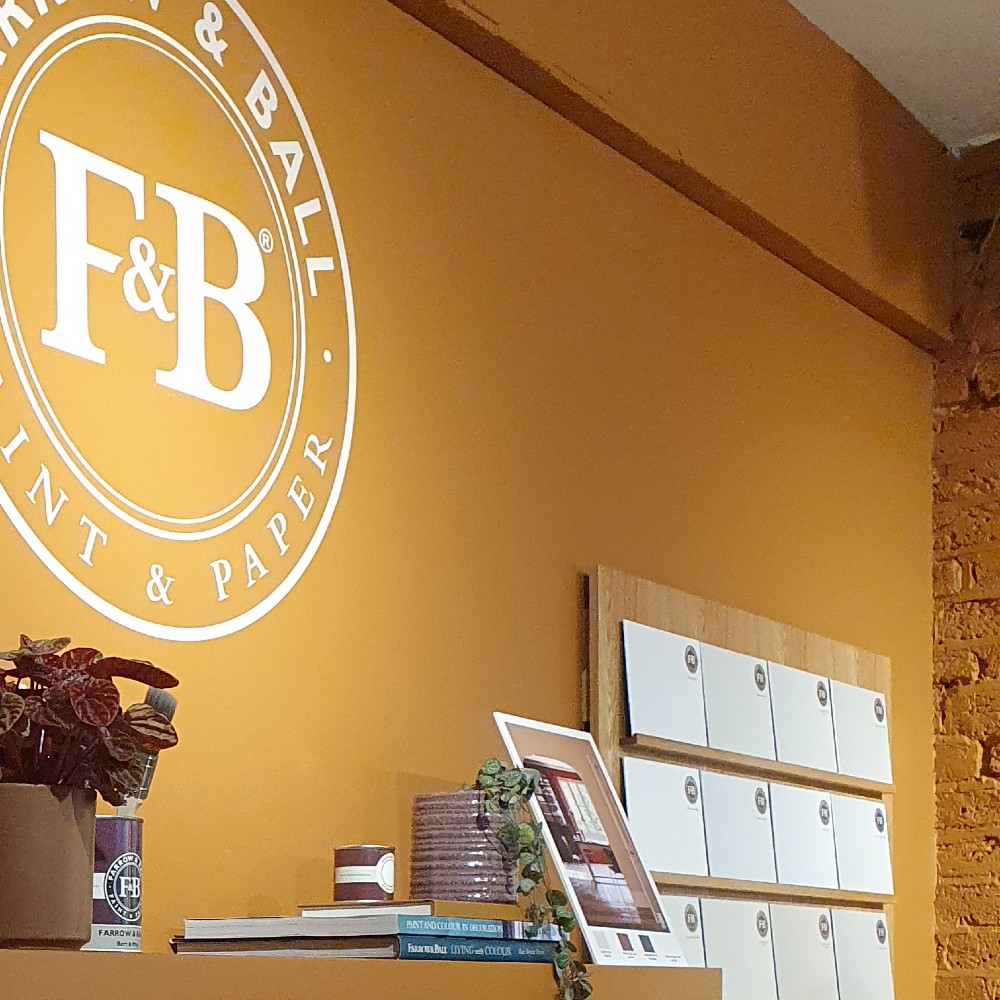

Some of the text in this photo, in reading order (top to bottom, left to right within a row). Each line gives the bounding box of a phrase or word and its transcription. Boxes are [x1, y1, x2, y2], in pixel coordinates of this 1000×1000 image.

[194, 1, 229, 68] &
[245, 76, 335, 298] BALL
[146, 563, 175, 606] &
[209, 436, 334, 603] PAPER
[406, 920, 424, 930] PAINT
[437, 921, 461, 932] COLOUR
[98, 929, 131, 937] FARROW
[450, 945, 475, 955] LIVING
[485, 945, 512, 956] COLOUR
